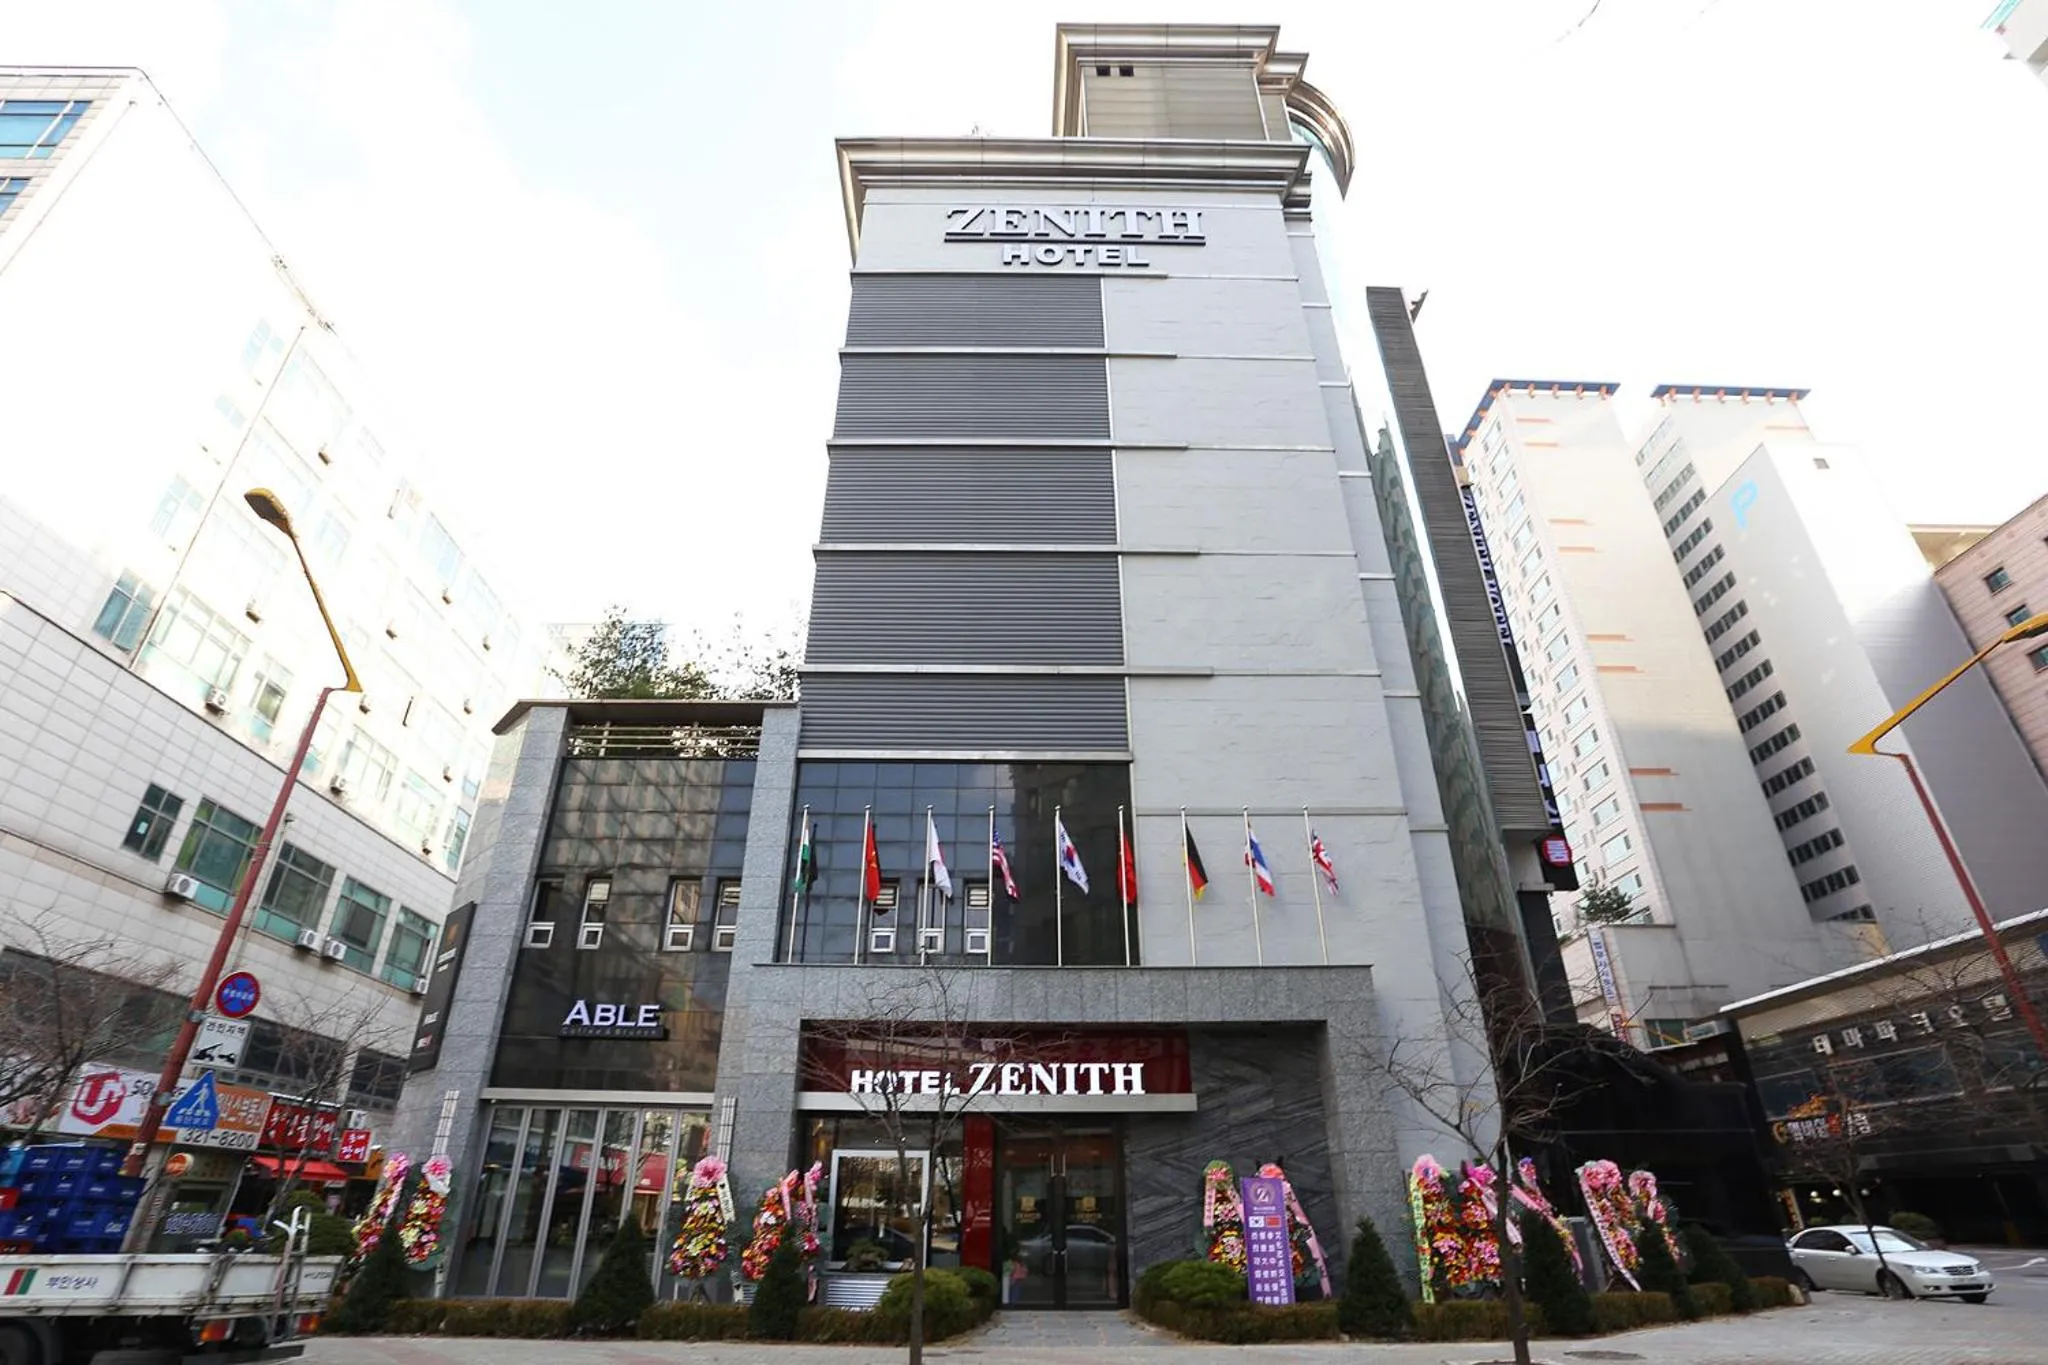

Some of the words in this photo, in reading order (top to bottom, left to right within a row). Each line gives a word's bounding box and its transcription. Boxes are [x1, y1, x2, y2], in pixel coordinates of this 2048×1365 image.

[946, 207, 1206, 240] ZENITH
[1002, 244, 1150, 267] HOTEL
[561, 999, 661, 1028] ABLE
[851, 1068, 961, 1095] HOTEL
[968, 1062, 1146, 1096] ZENITH
[184, 1128, 255, 1149] 321-8200
